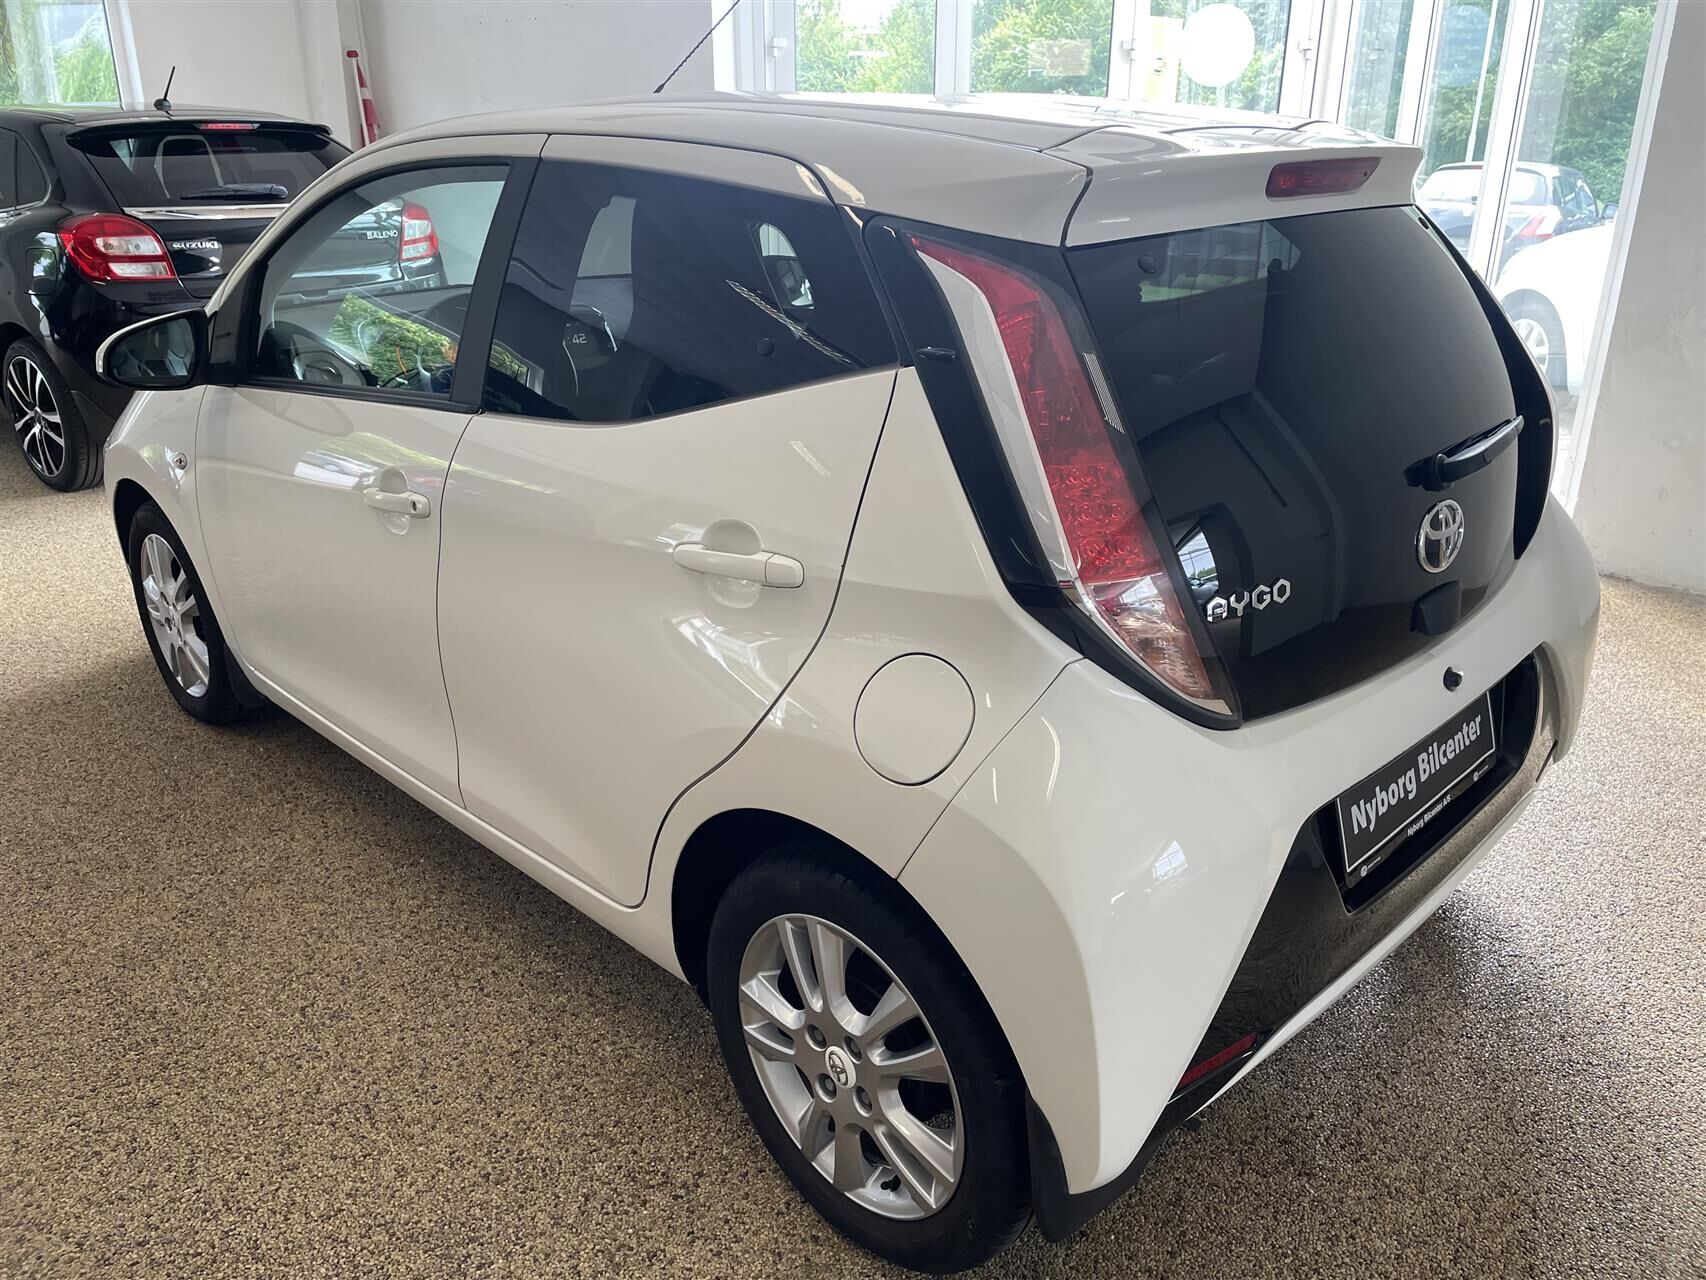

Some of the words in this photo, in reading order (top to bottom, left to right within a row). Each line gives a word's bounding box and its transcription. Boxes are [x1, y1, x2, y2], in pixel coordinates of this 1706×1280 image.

[172, 240, 219, 249] SUZUKI
[366, 230, 399, 240] BALENO
[1206, 578, 1291, 623] AYGO
[1350, 768, 1417, 835] Nyborg
[1417, 714, 1482, 782] Bilcenter
[1407, 818, 1424, 837] Nyborg
[1423, 802, 1443, 823] Bilcenter
